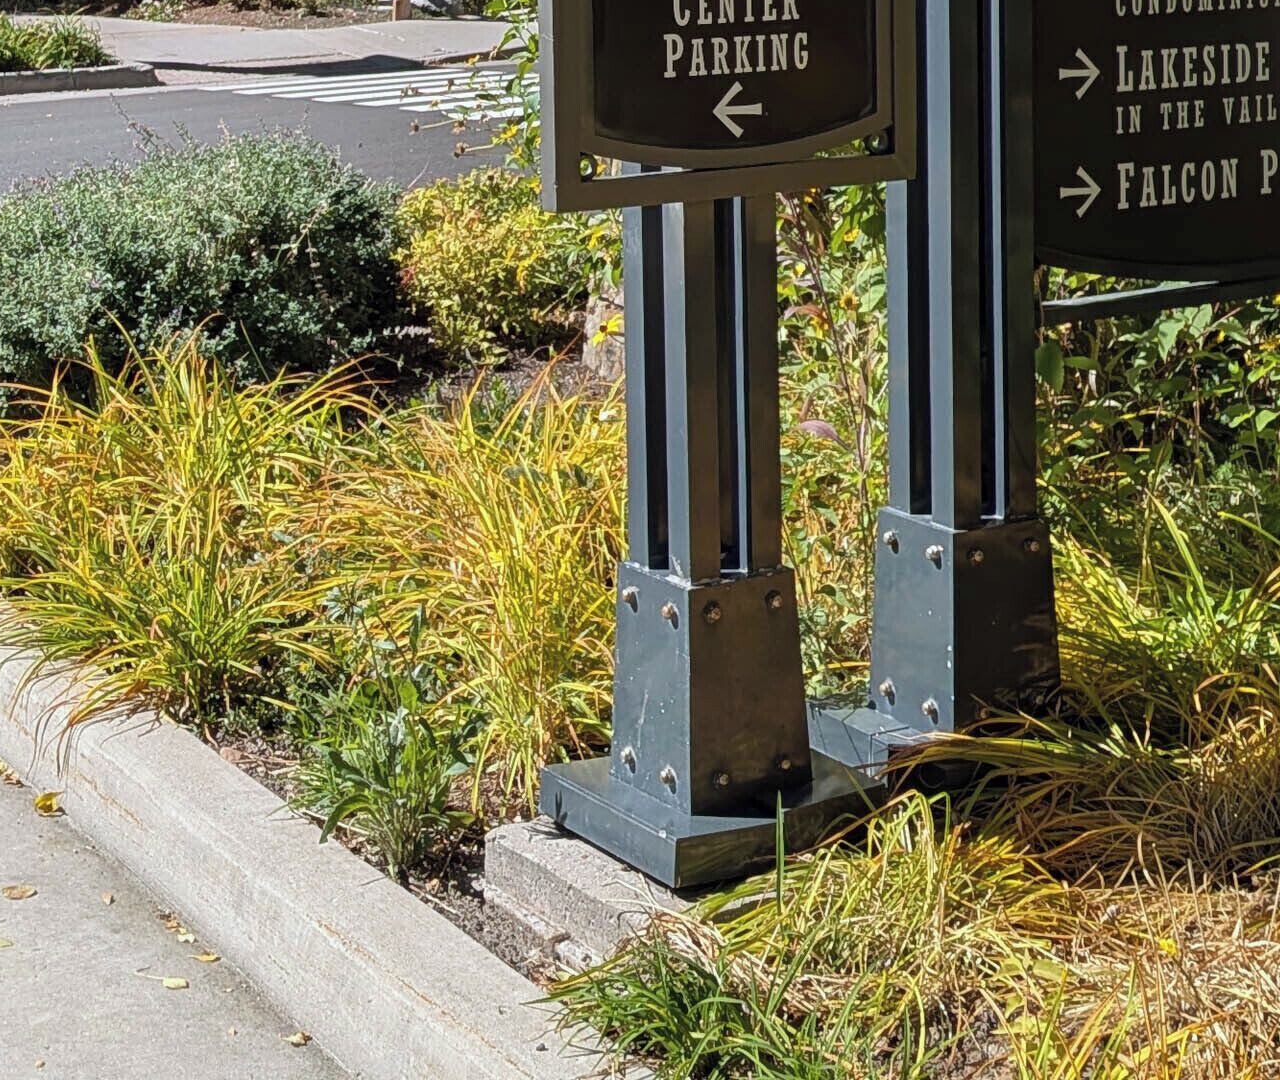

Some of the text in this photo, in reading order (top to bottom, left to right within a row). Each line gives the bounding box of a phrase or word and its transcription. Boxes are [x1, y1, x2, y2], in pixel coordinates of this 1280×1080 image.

[663, 32, 809, 78] PARKING
[1116, 41, 1270, 93] LAKESIDE
[1116, 105, 1142, 135] IN
[1160, 100, 1205, 130] THE
[1222, 94, 1277, 125] VAIL
[1117, 157, 1239, 210] FALCON
